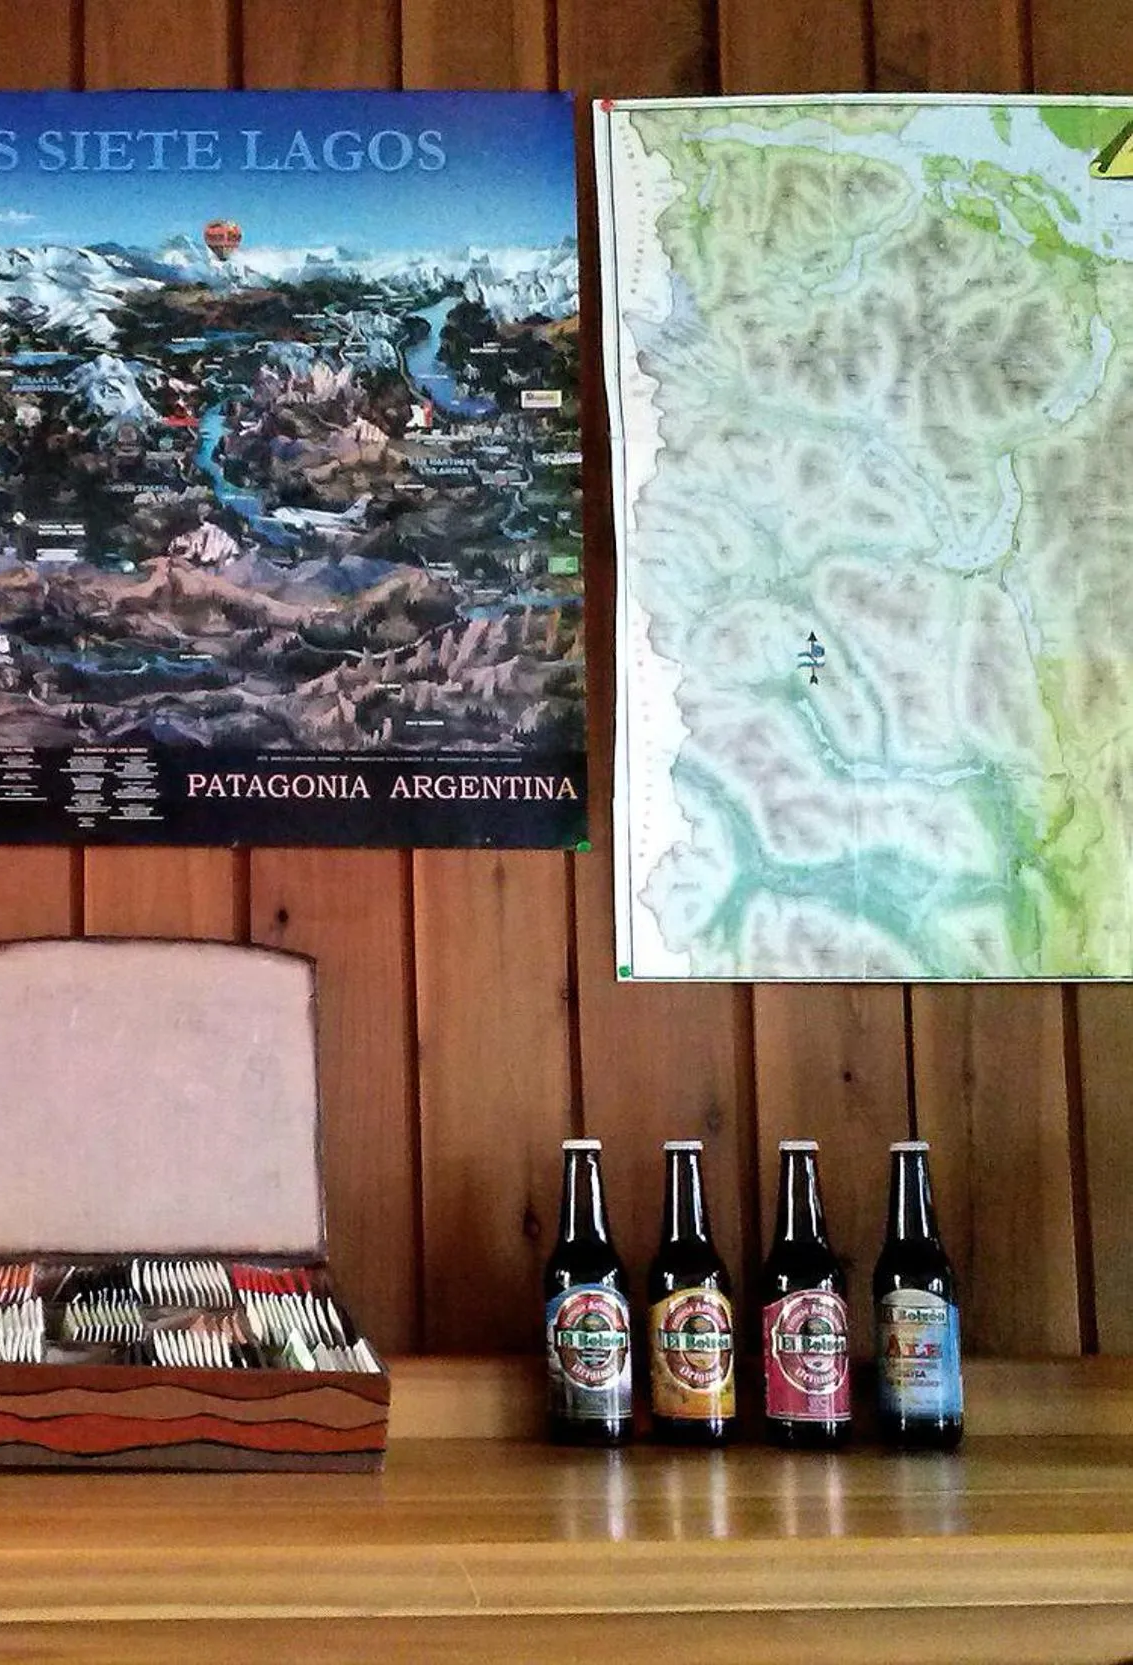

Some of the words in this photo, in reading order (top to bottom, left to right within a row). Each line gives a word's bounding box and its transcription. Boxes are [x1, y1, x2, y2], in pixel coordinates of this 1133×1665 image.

[37, 129, 222, 172] SIETE
[239, 129, 448, 172] LAGOS
[186, 773, 370, 799] PATAGONIA
[389, 774, 578, 801] ARGENTINA
